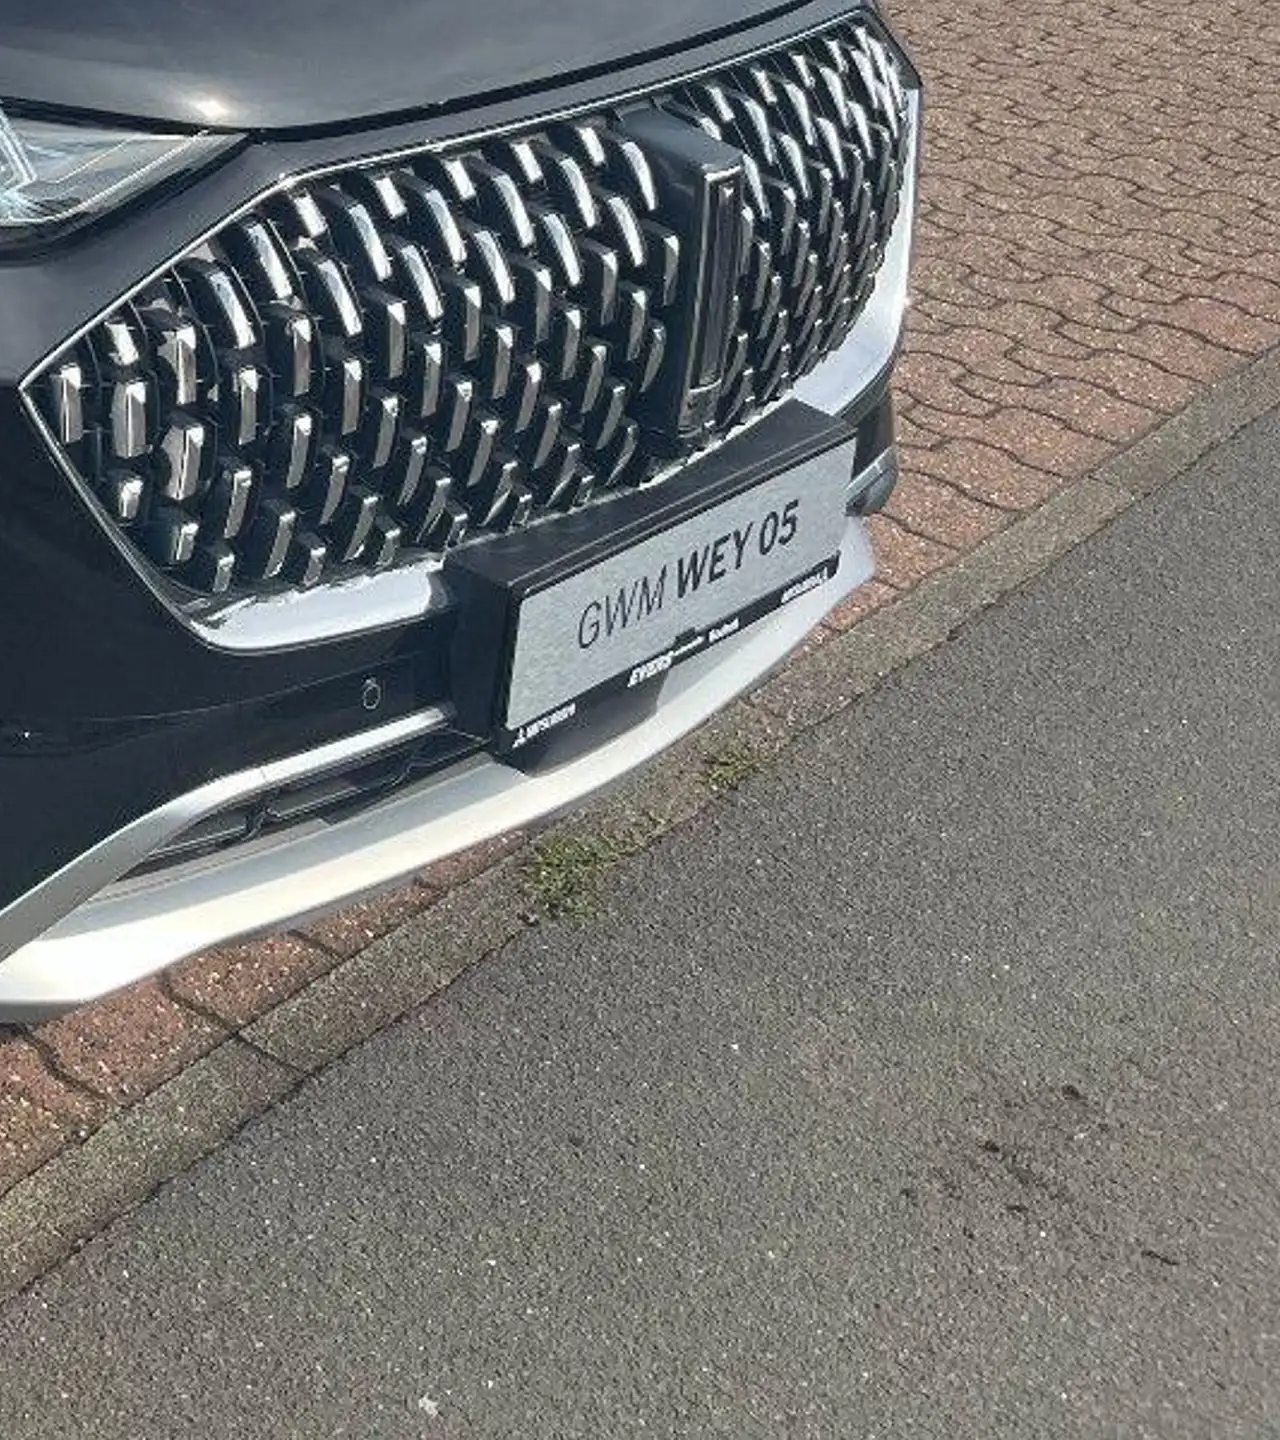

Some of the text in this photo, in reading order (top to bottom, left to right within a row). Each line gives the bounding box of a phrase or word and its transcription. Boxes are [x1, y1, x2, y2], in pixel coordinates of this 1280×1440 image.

[578, 564, 668, 650] GWM
[676, 521, 755, 599] WEY
[758, 498, 800, 556] 05
